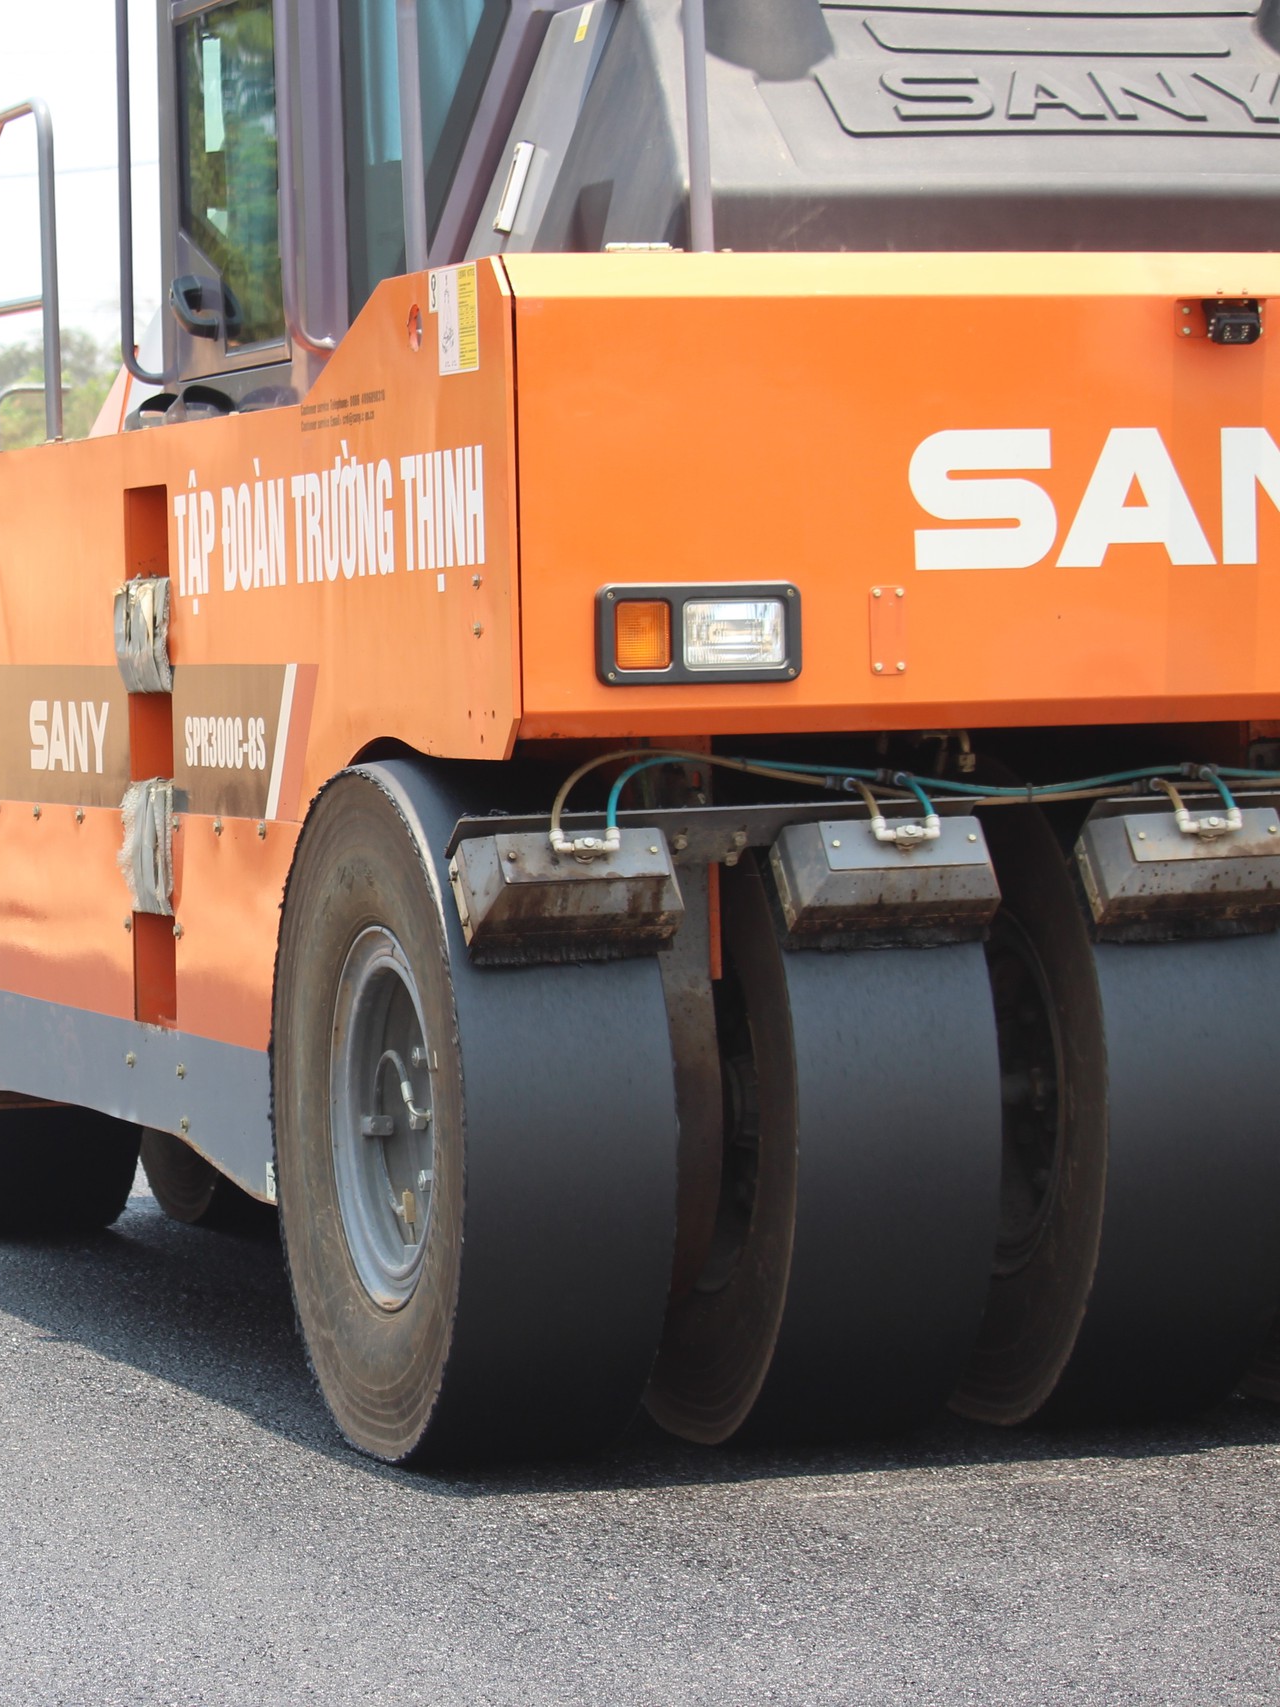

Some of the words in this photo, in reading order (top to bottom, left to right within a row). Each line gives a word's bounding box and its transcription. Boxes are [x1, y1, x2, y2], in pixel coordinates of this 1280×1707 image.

[879, 69, 1280, 123] SANY
[174, 468, 216, 615] TẬP
[221, 457, 287, 592] ĐOÀN
[291, 439, 395, 584] TRƯỜNG
[400, 444, 486, 593] THỊNH
[28, 699, 110, 774] SANY
[184, 715, 267, 771] SPR300C-8S
